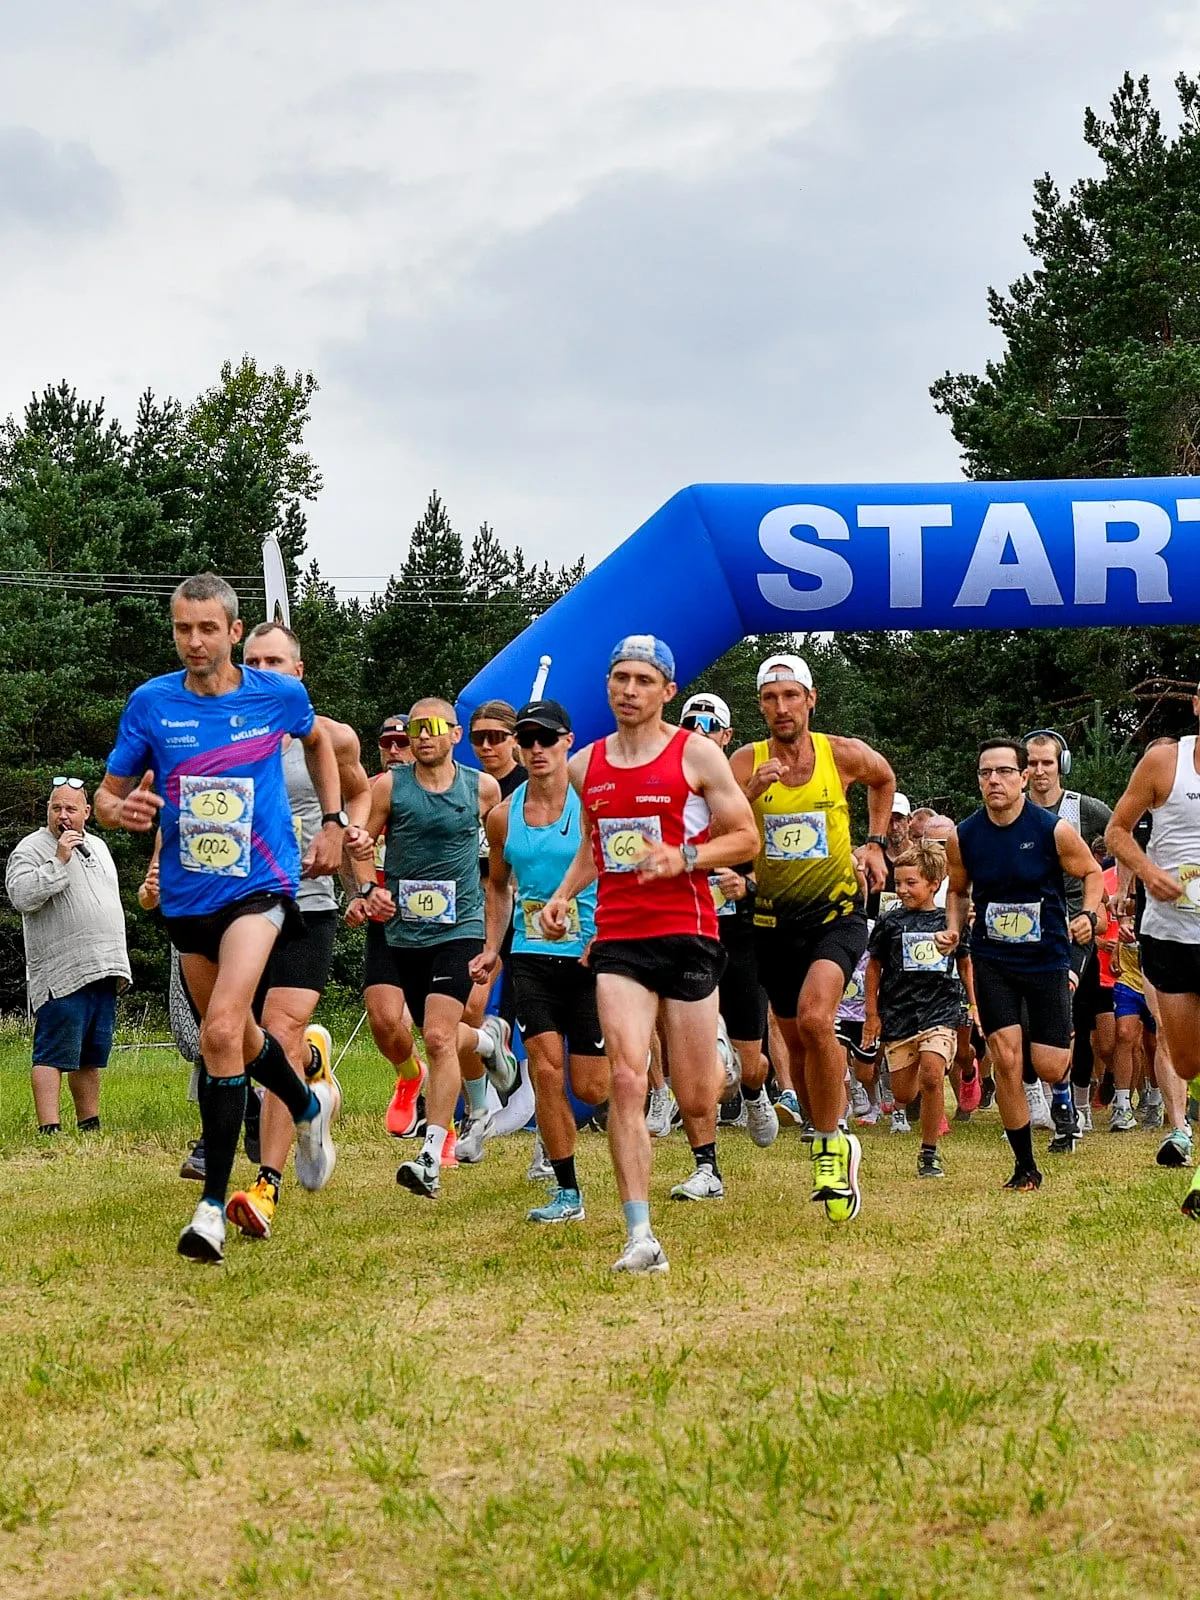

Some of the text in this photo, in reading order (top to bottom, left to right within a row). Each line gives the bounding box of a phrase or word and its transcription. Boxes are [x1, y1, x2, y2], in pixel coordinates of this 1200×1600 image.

[201, 791, 228, 816] 38
[196, 837, 230, 855] 1002
[613, 835, 636, 857] 66
[782, 829, 801, 848] 57
[418, 893, 434, 911] 49
[1000, 913, 1019, 934] 71
[914, 942, 935, 961] 69
